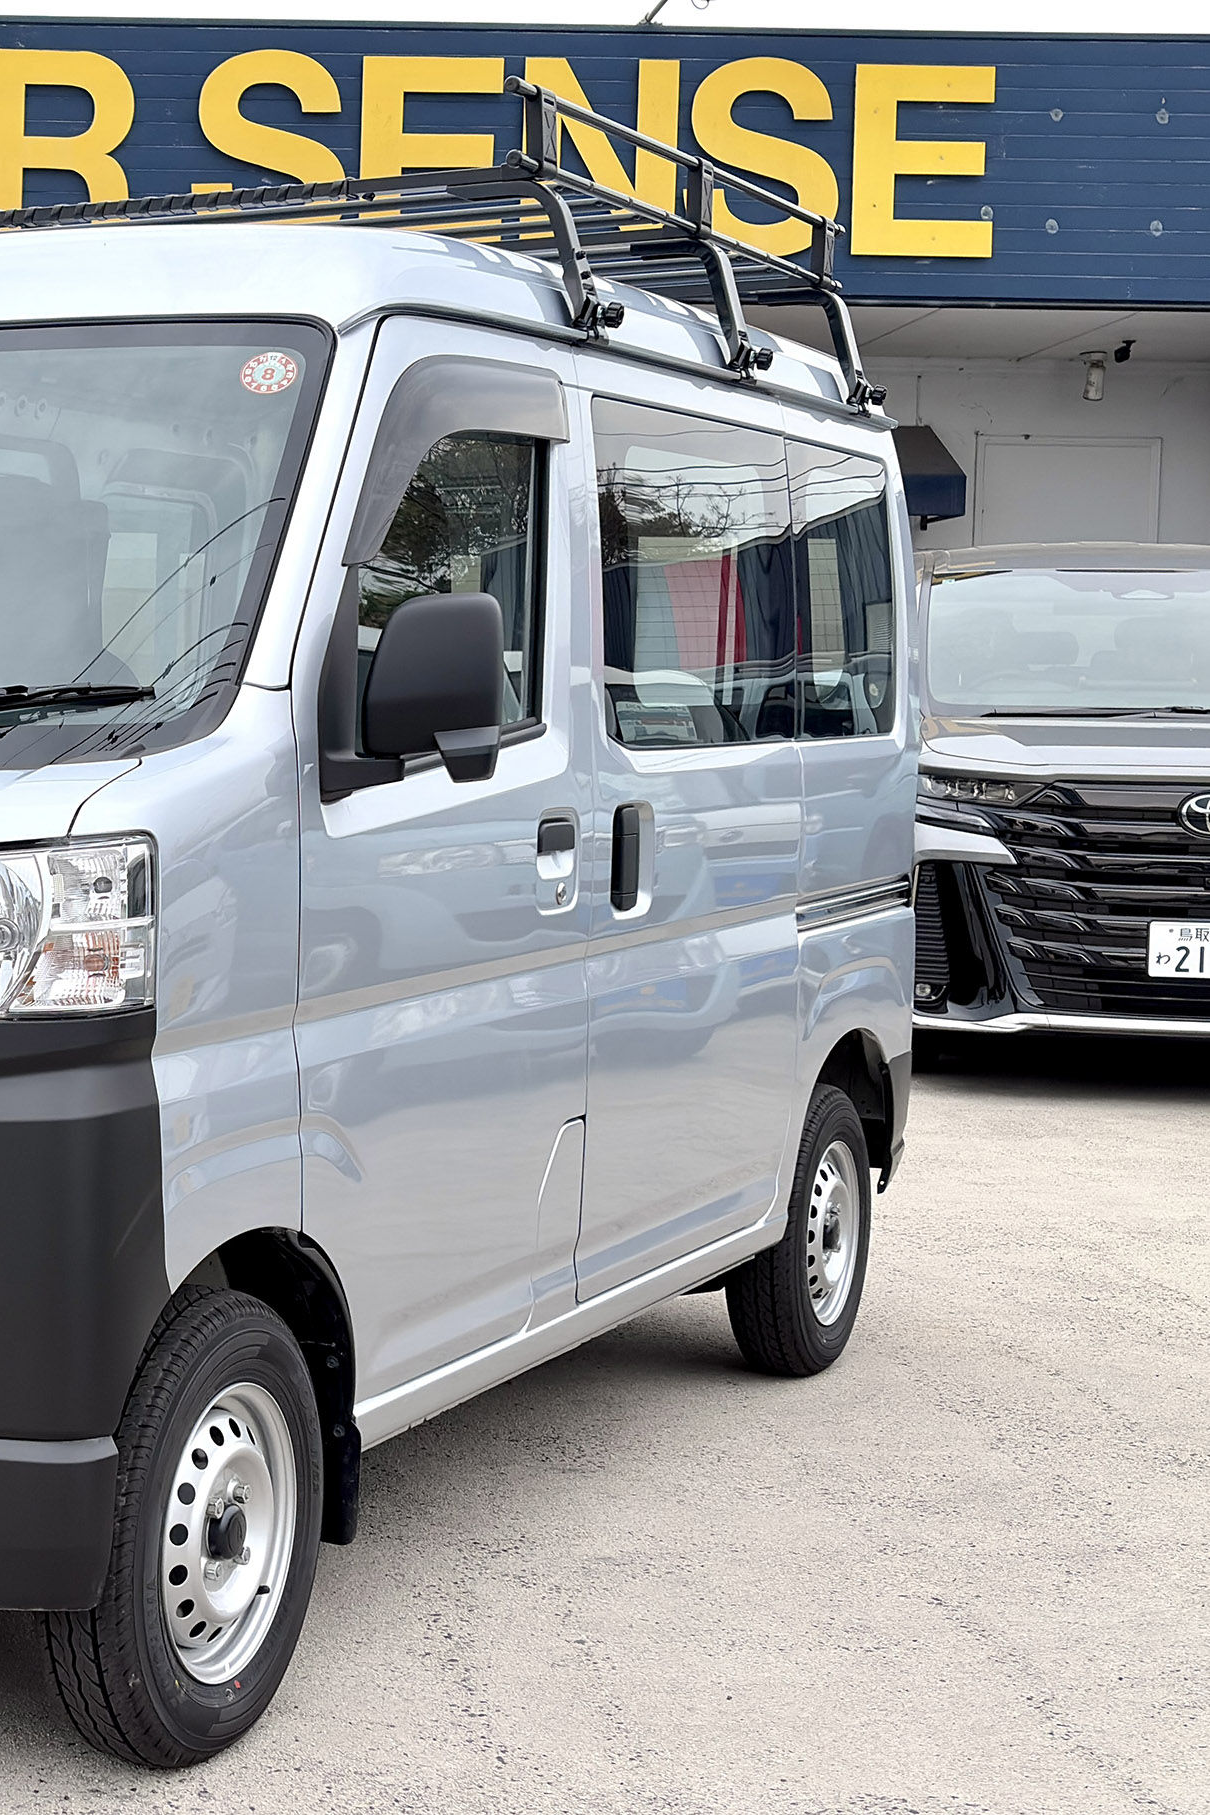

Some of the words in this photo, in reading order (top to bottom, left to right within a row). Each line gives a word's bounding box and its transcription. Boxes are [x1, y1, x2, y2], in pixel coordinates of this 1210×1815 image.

[192, 49, 996, 257] SENSE
[261, 368, 275, 381] 8
[1178, 927, 1210, 942] 鳥取
[1156, 951, 1171, 965] わ
[1174, 945, 1205, 974] 21
